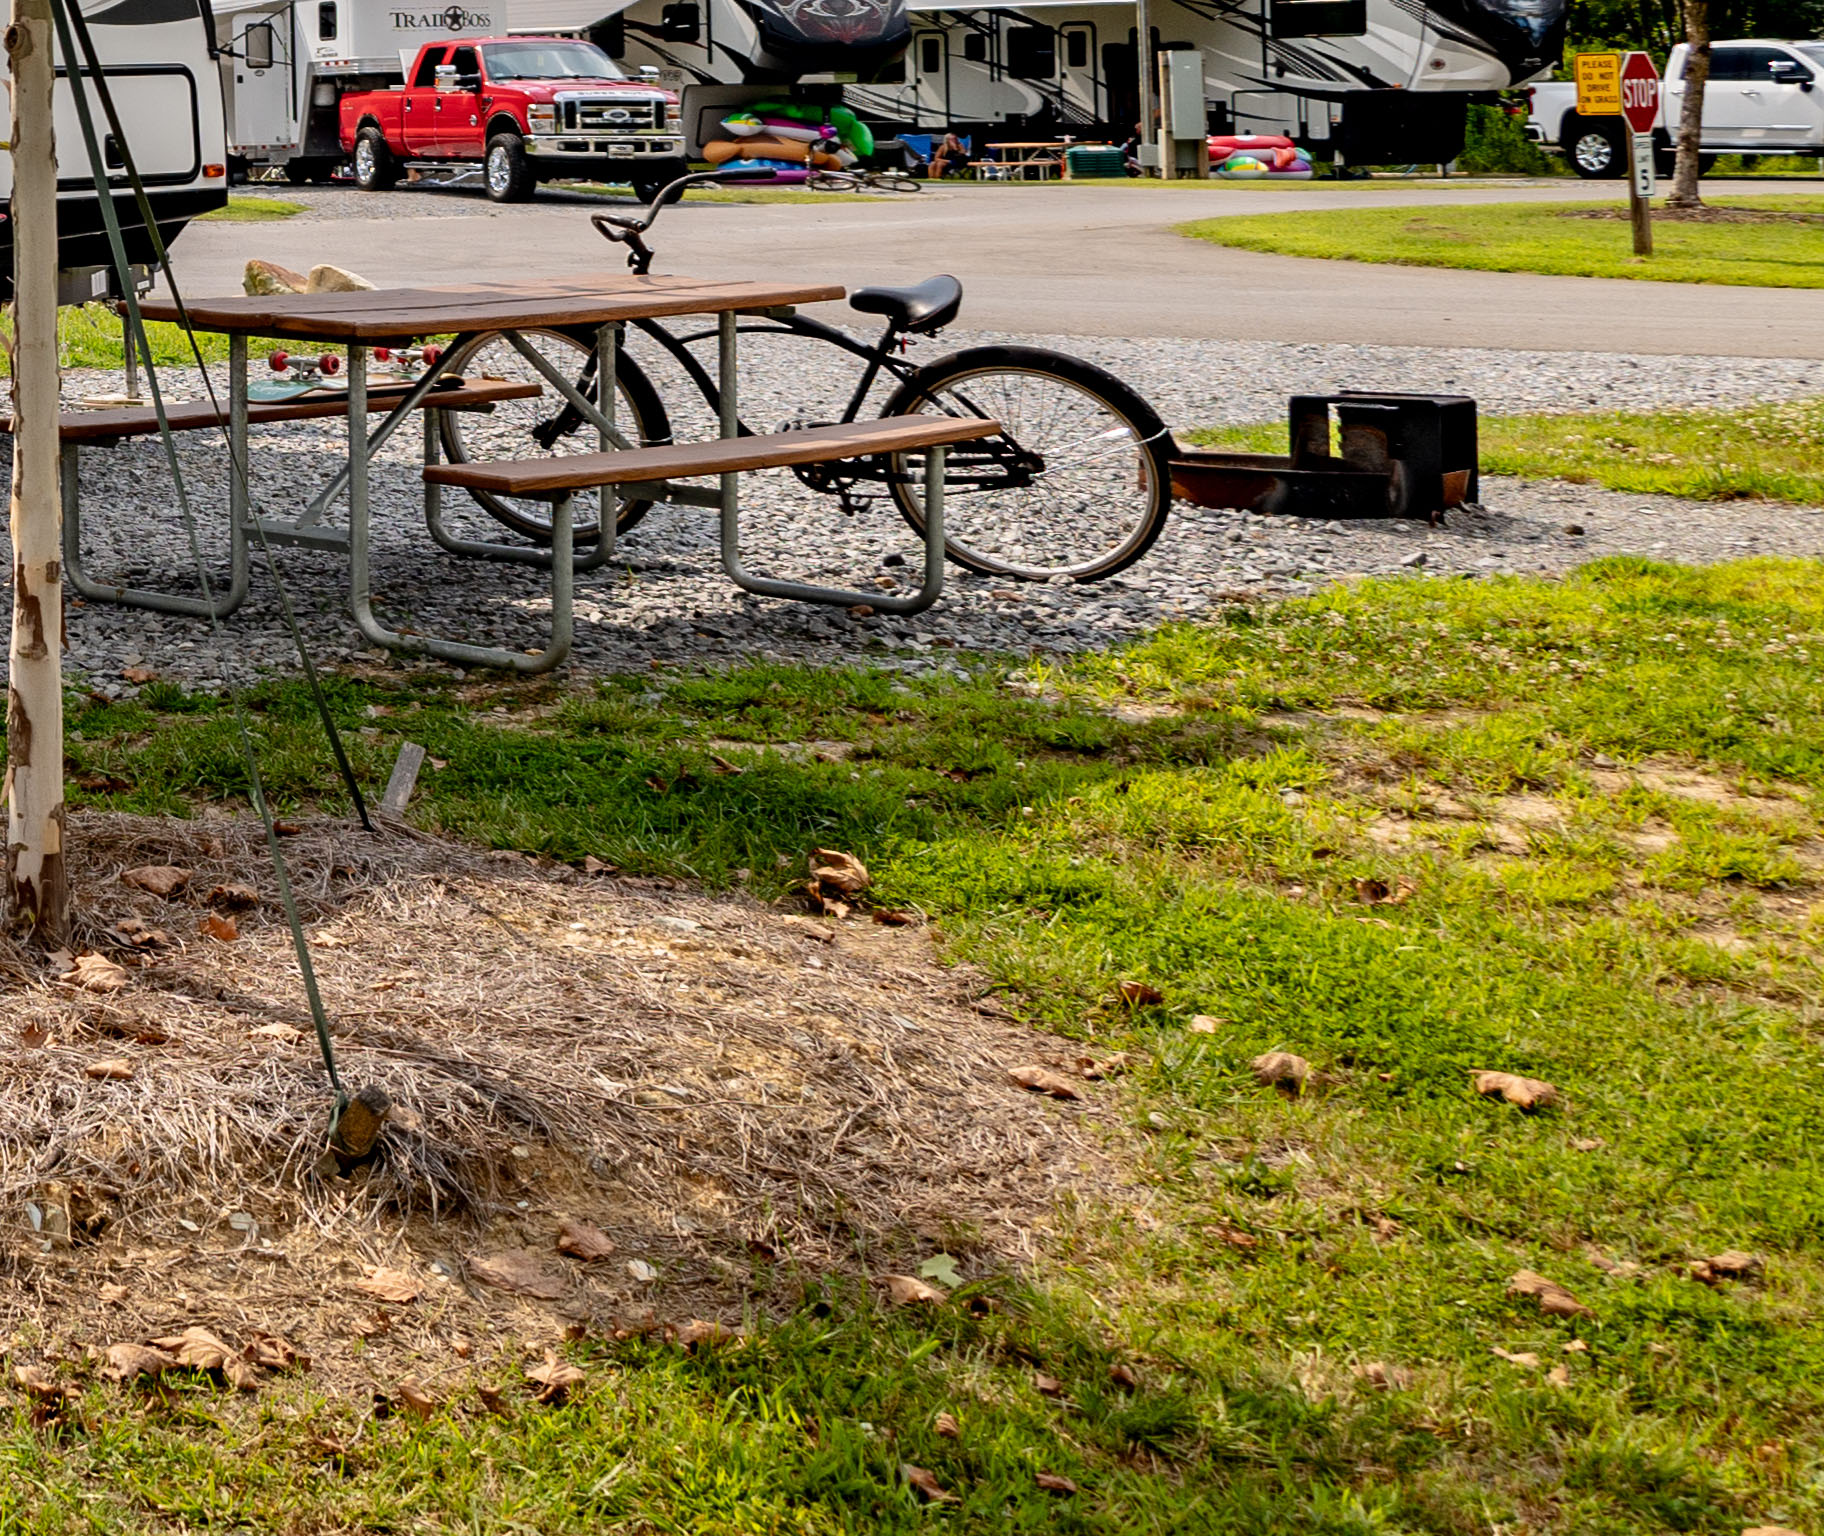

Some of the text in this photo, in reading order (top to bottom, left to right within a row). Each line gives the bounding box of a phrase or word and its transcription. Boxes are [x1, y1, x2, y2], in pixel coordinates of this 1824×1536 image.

[389, 10, 491, 28] TRAIL BOSS
[1582, 72, 1613, 80] DO NOT
[1587, 84, 1611, 92] DRIVE
[1624, 78, 1656, 109] STOP
[1580, 95, 1617, 104] ON GRASS
[1640, 169, 1649, 190] 5
